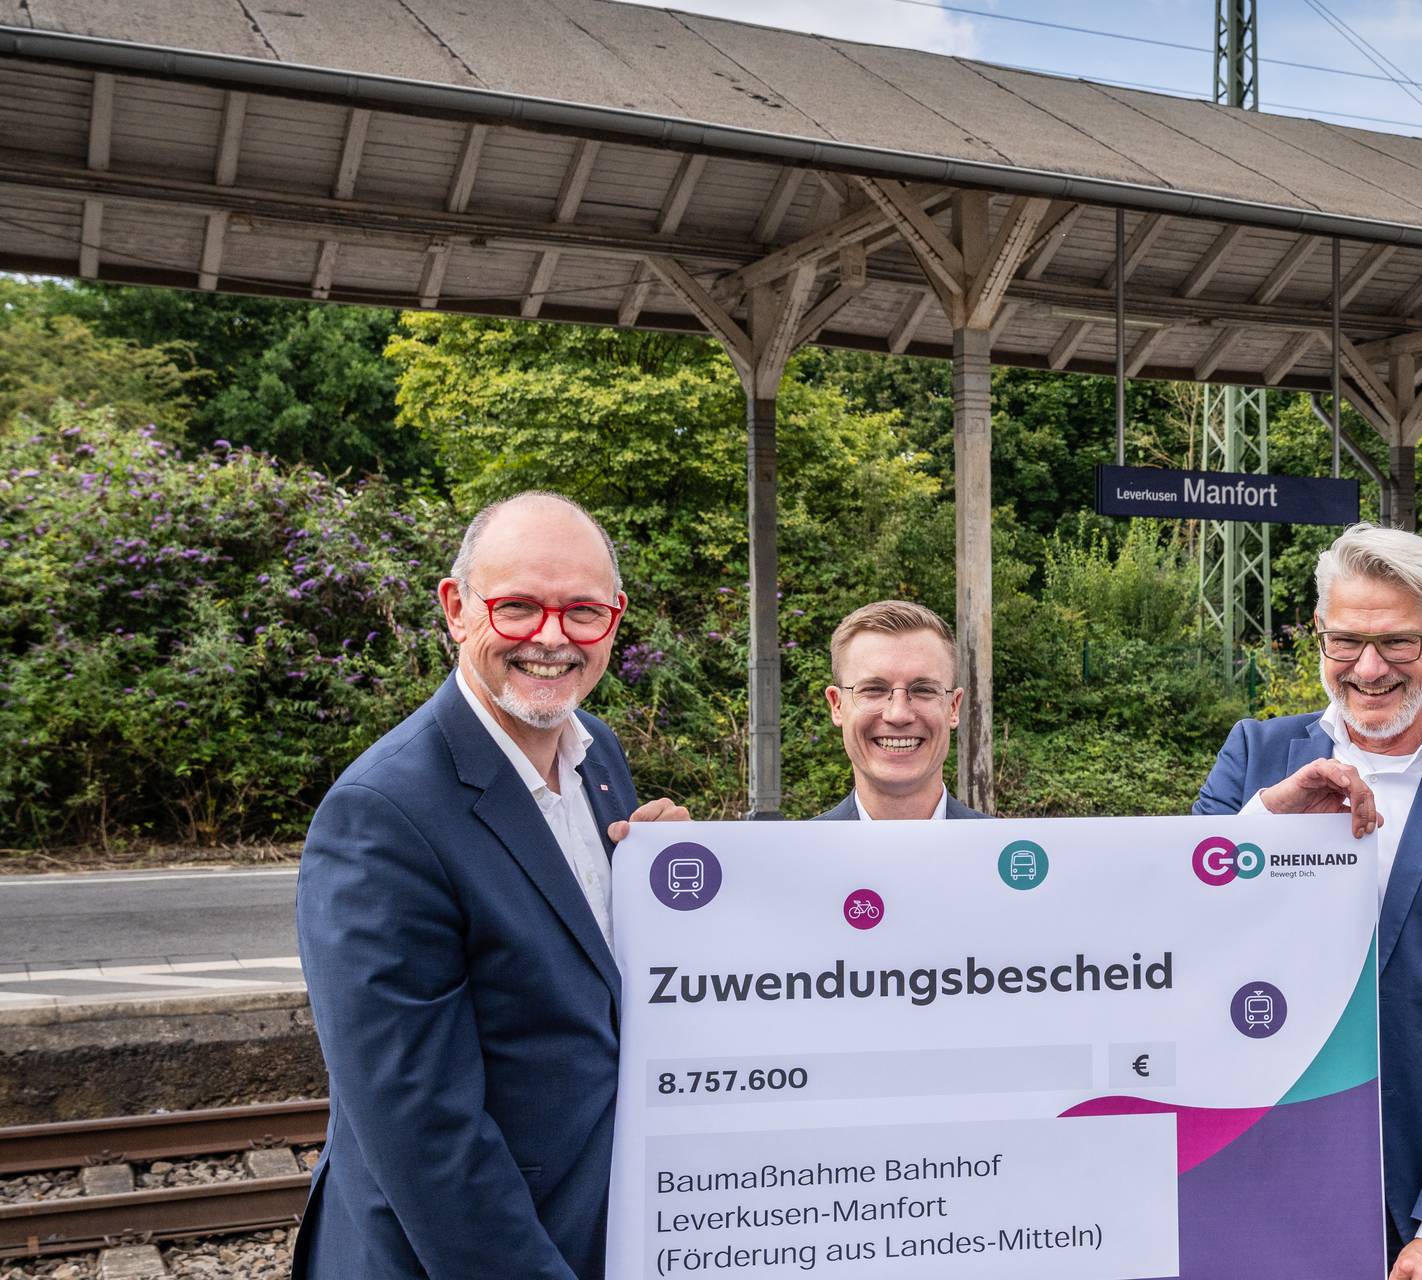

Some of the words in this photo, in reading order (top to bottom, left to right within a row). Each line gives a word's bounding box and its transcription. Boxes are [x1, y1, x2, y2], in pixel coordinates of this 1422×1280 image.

[1116, 487, 1178, 502] Leverkusen
[1183, 478, 1278, 507] Manfort
[1270, 853, 1358, 867] RHEINLAND
[1270, 870, 1298, 880] Bewegt
[1298, 869, 1317, 878] Dich.
[648, 952, 1173, 1006] Zuwendungsbescheid
[658, 1067, 808, 1095] 8.757.600
[1132, 1054, 1150, 1077] €
[657, 1162, 876, 1194] Baumaßnahme
[885, 1153, 1003, 1182] Bahnhof
[657, 1196, 948, 1233] Leverkusen-Manfort
[656, 1242, 816, 1277] (Förderung
[826, 1242, 876, 1262] aus
[886, 1223, 1103, 1258] Landes-Mitteln)
